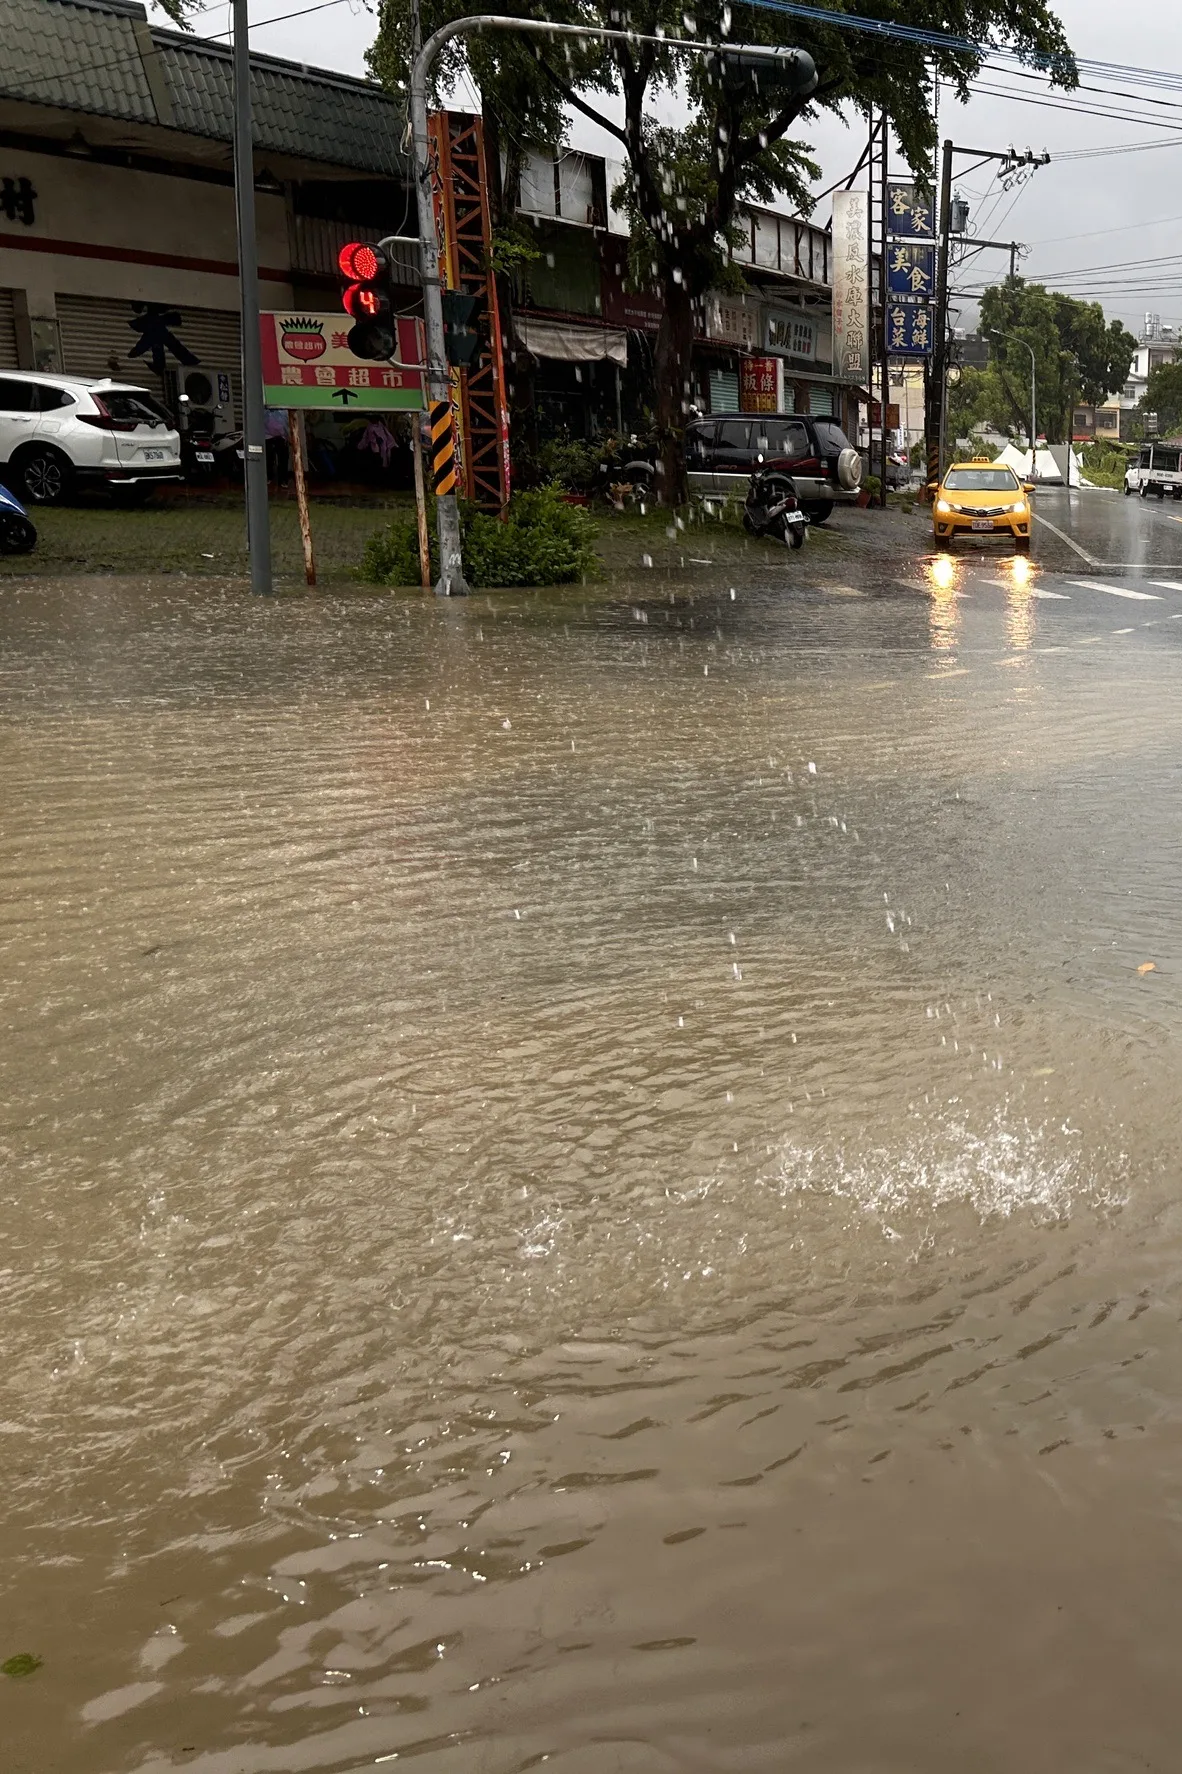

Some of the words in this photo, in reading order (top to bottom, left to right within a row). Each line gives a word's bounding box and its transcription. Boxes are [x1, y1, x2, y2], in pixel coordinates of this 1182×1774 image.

[889, 188, 931, 232] 客家
[845, 197, 865, 372] 美濃反水庫大聯盟
[889, 247, 931, 292] 美食
[360, 291, 376, 314] 4
[890, 306, 909, 348] 台菜
[911, 309, 931, 350] 海鮮
